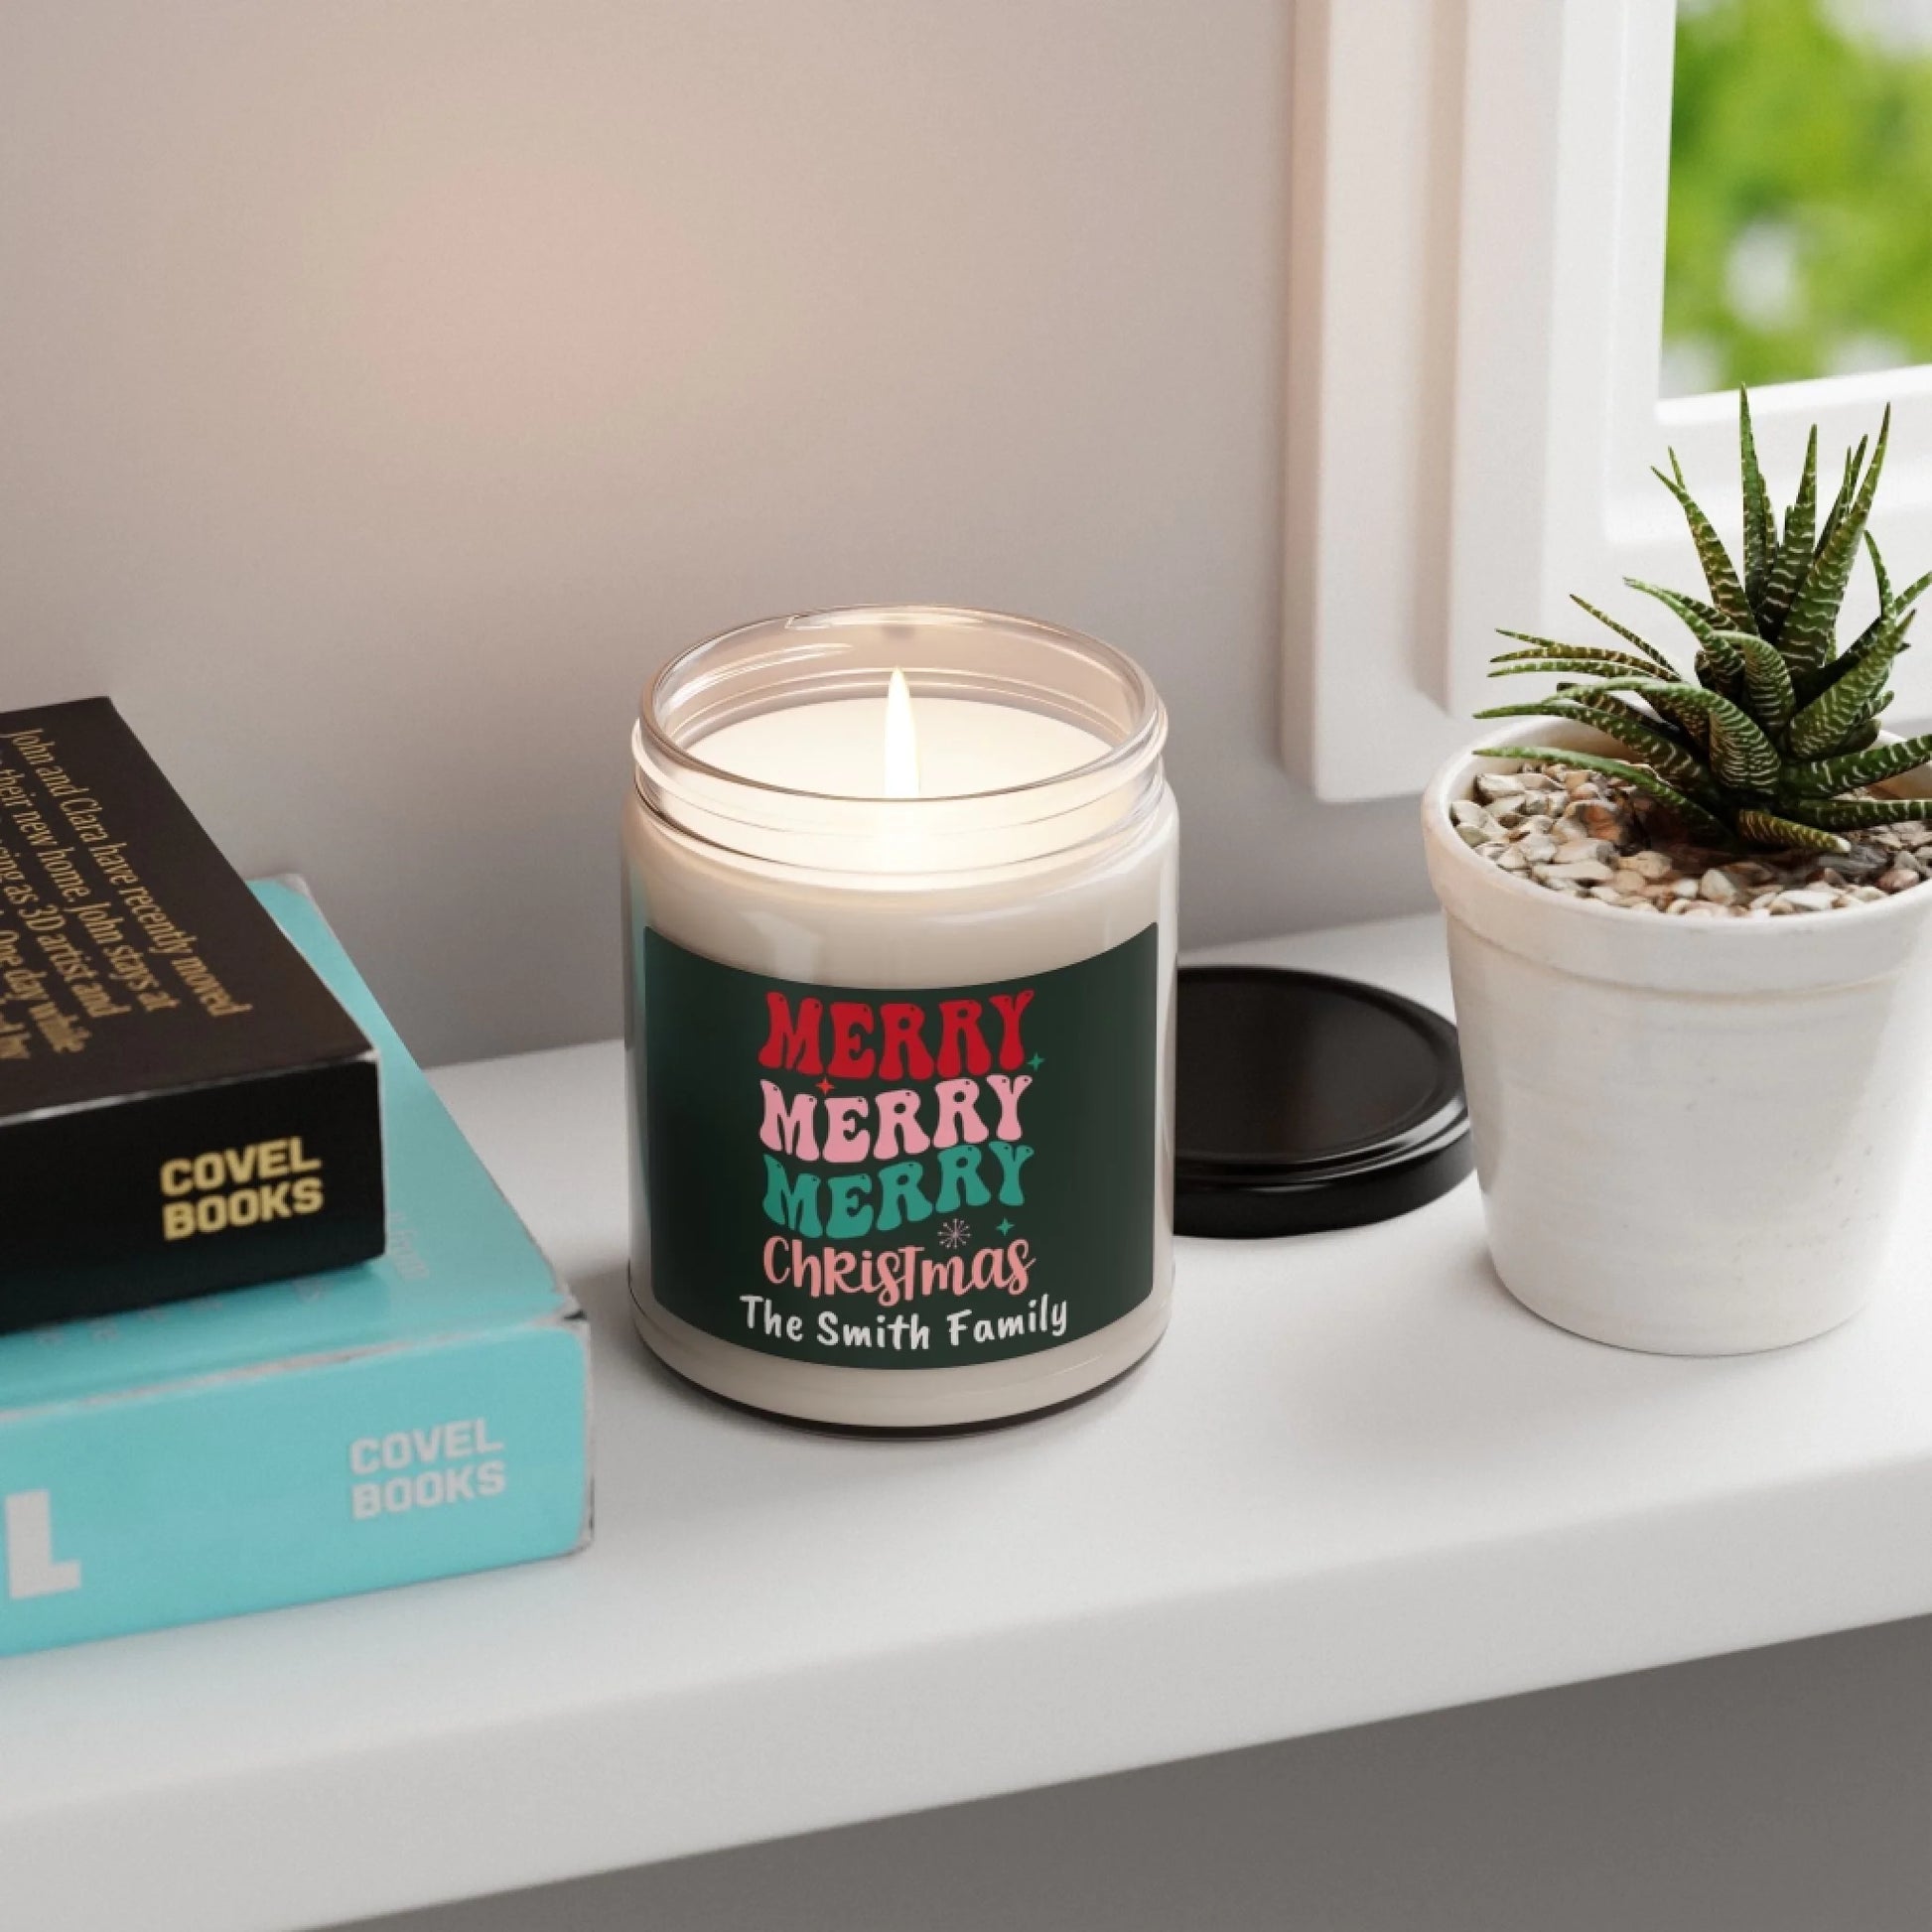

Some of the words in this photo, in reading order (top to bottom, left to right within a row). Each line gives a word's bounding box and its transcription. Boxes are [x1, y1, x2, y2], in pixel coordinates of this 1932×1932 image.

[0, 728, 56, 765] John
[35, 764, 90, 797] and
[60, 797, 109, 842] Clara
[87, 842, 138, 886] have
[3, 883, 40, 904] as
[12, 810, 59, 846] new
[37, 846, 91, 902] home.
[64, 900, 125, 945] John
[102, 943, 162, 993] stays
[137, 989, 182, 1013] at
[18, 903, 67, 931] 3D
[118, 886, 199, 954] recently
[37, 933, 98, 983] artist
[71, 981, 132, 1019] and
[171, 956, 253, 1018] moved
[758, 988, 1035, 1081] MERRY
[759, 1073, 1034, 1164] MERRY
[160, 1137, 322, 1196] COVEL
[761, 1141, 1035, 1240] MERRY
[162, 1178, 324, 1241] BOOKS
[740, 1294, 803, 1342] The
[816, 1311, 930, 1350] Smith
[946, 1293, 1068, 1346] Family
[350, 1418, 504, 1475] COVEL
[351, 1460, 507, 1520] BOOKS
